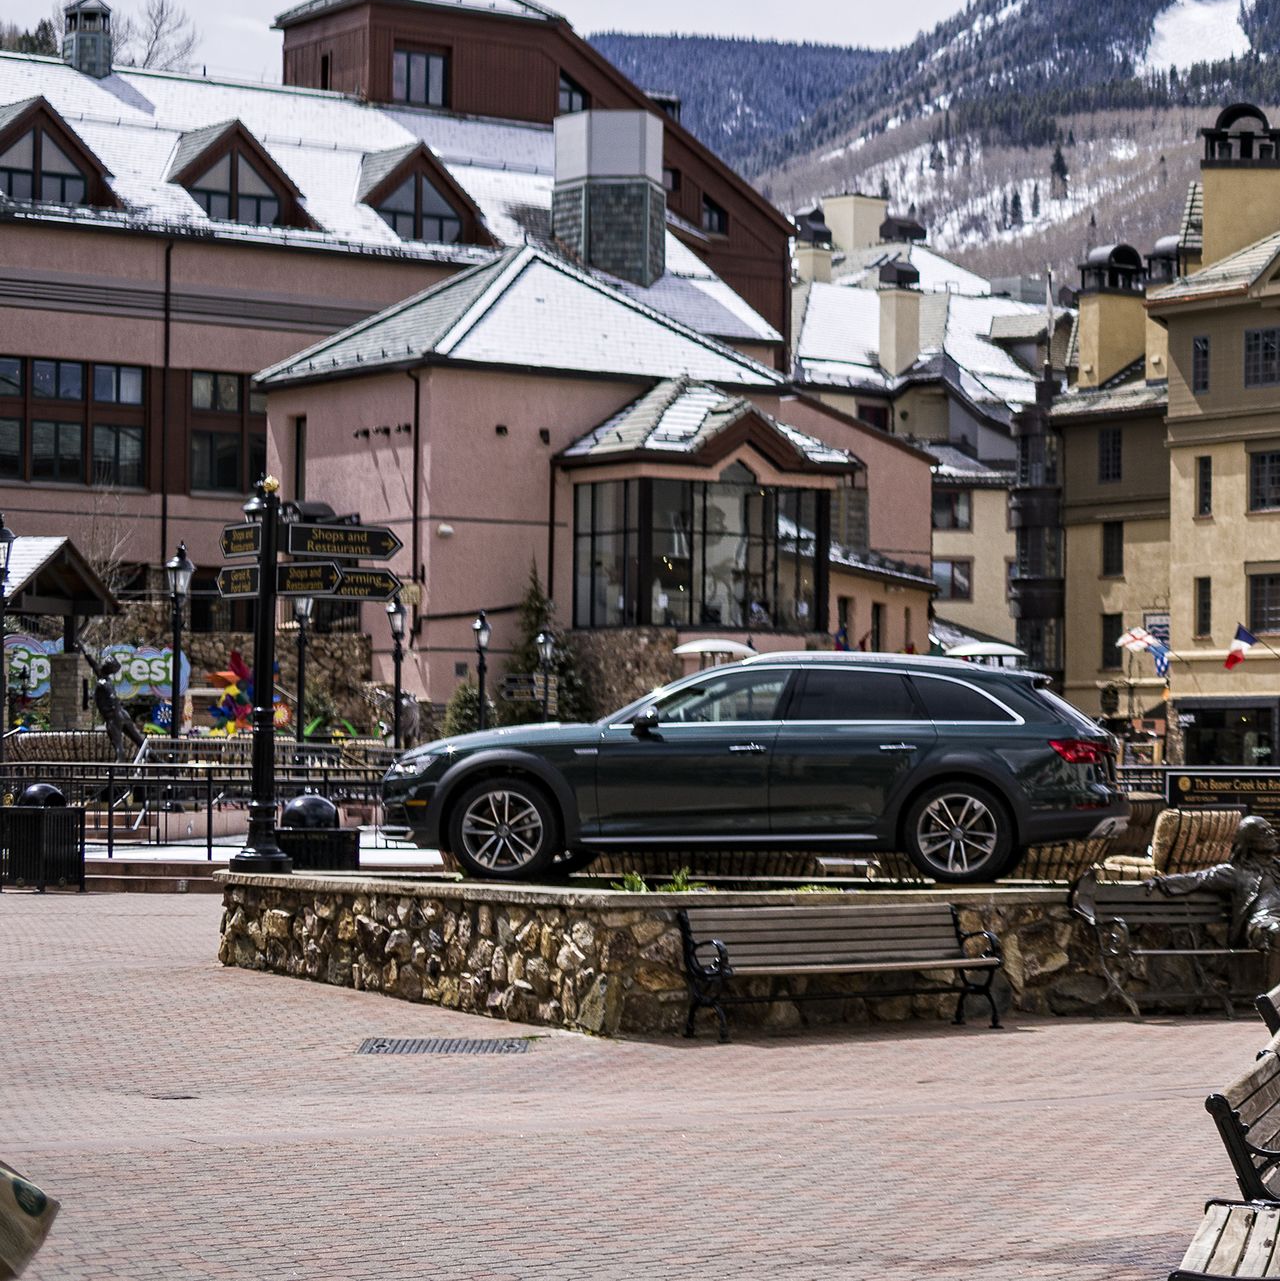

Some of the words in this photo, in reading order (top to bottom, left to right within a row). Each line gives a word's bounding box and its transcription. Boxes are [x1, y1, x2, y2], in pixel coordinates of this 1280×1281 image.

[311, 527, 343, 543] Shops
[348, 530, 368, 542] and
[306, 540, 371, 555] Restaurants
[338, 586, 371, 596] enter
[1195, 778, 1208, 790] The
[1209, 778, 1231, 790] Beaver
[1233, 778, 1254, 790] Creek
